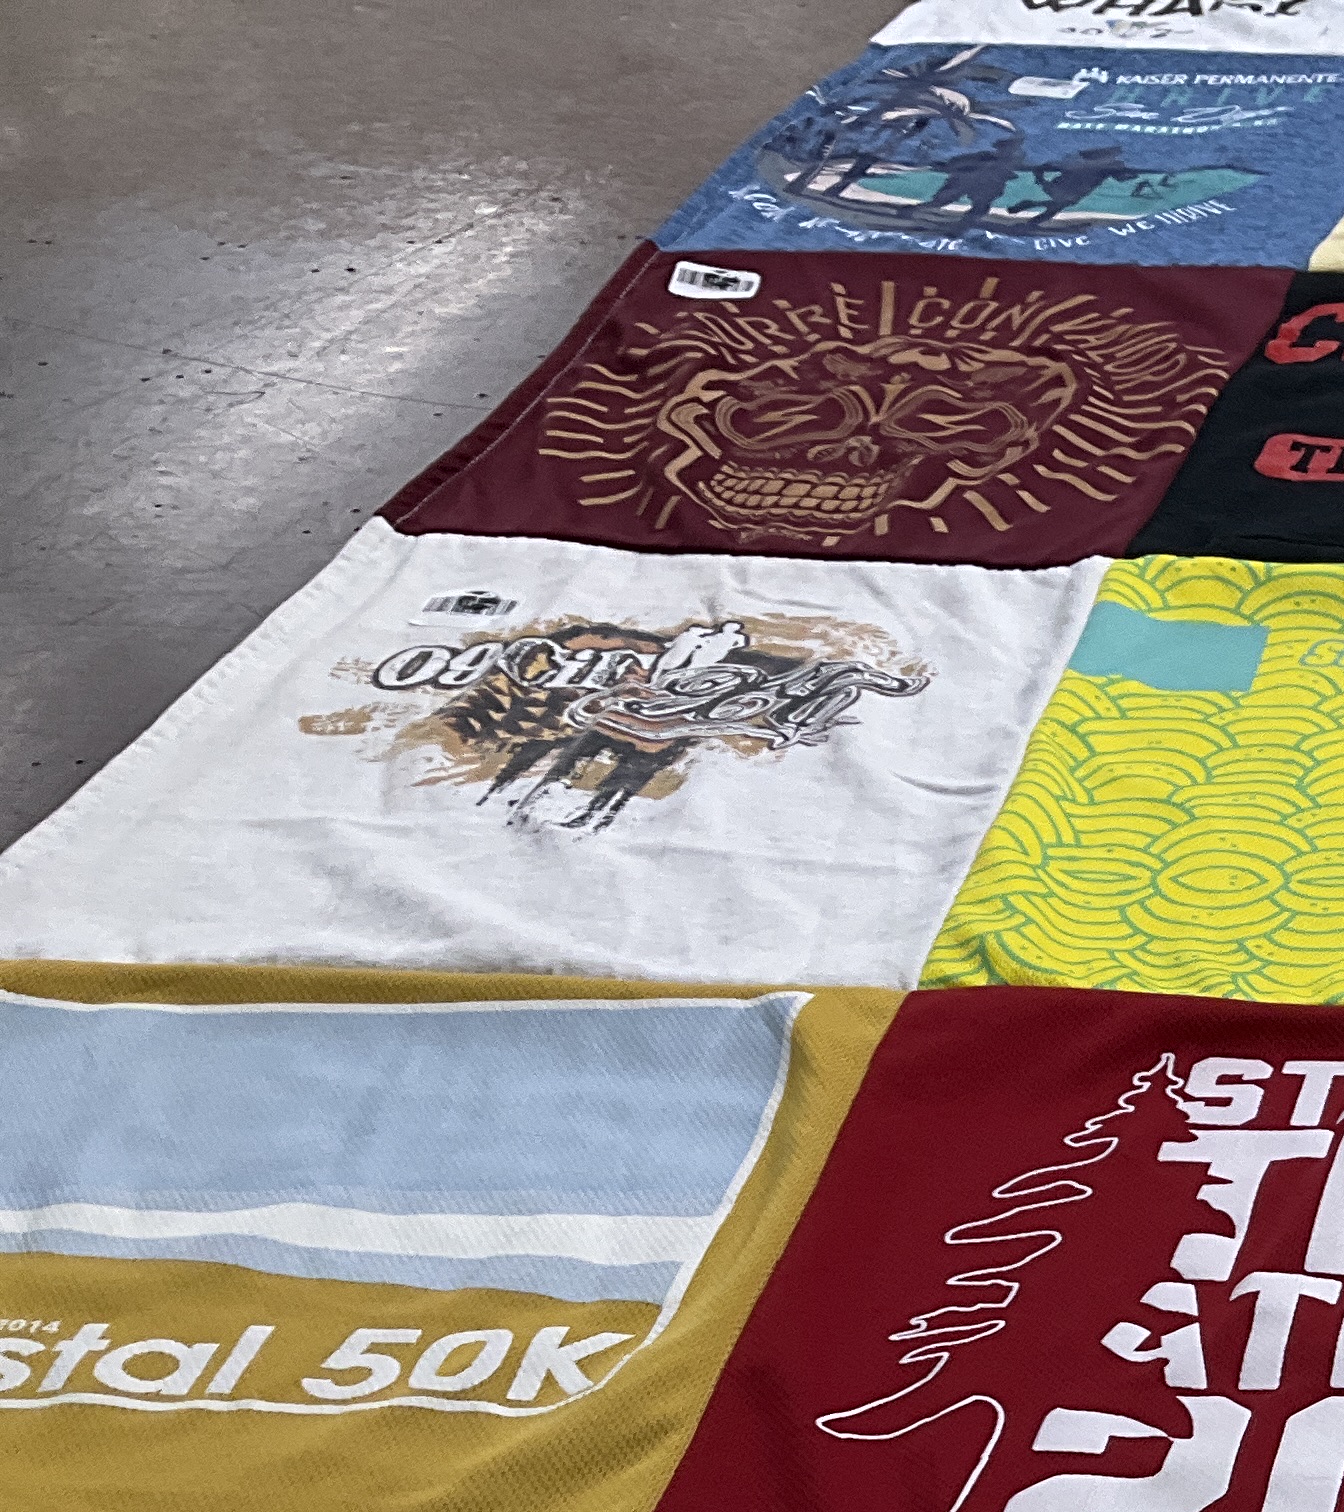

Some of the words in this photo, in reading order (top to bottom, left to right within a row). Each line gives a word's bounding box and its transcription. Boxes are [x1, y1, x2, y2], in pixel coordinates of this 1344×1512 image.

[1116, 74, 1188, 85] KAISER
[1194, 73, 1342, 85] PERMANENTE
[300, 1325, 636, 1401] 50K
